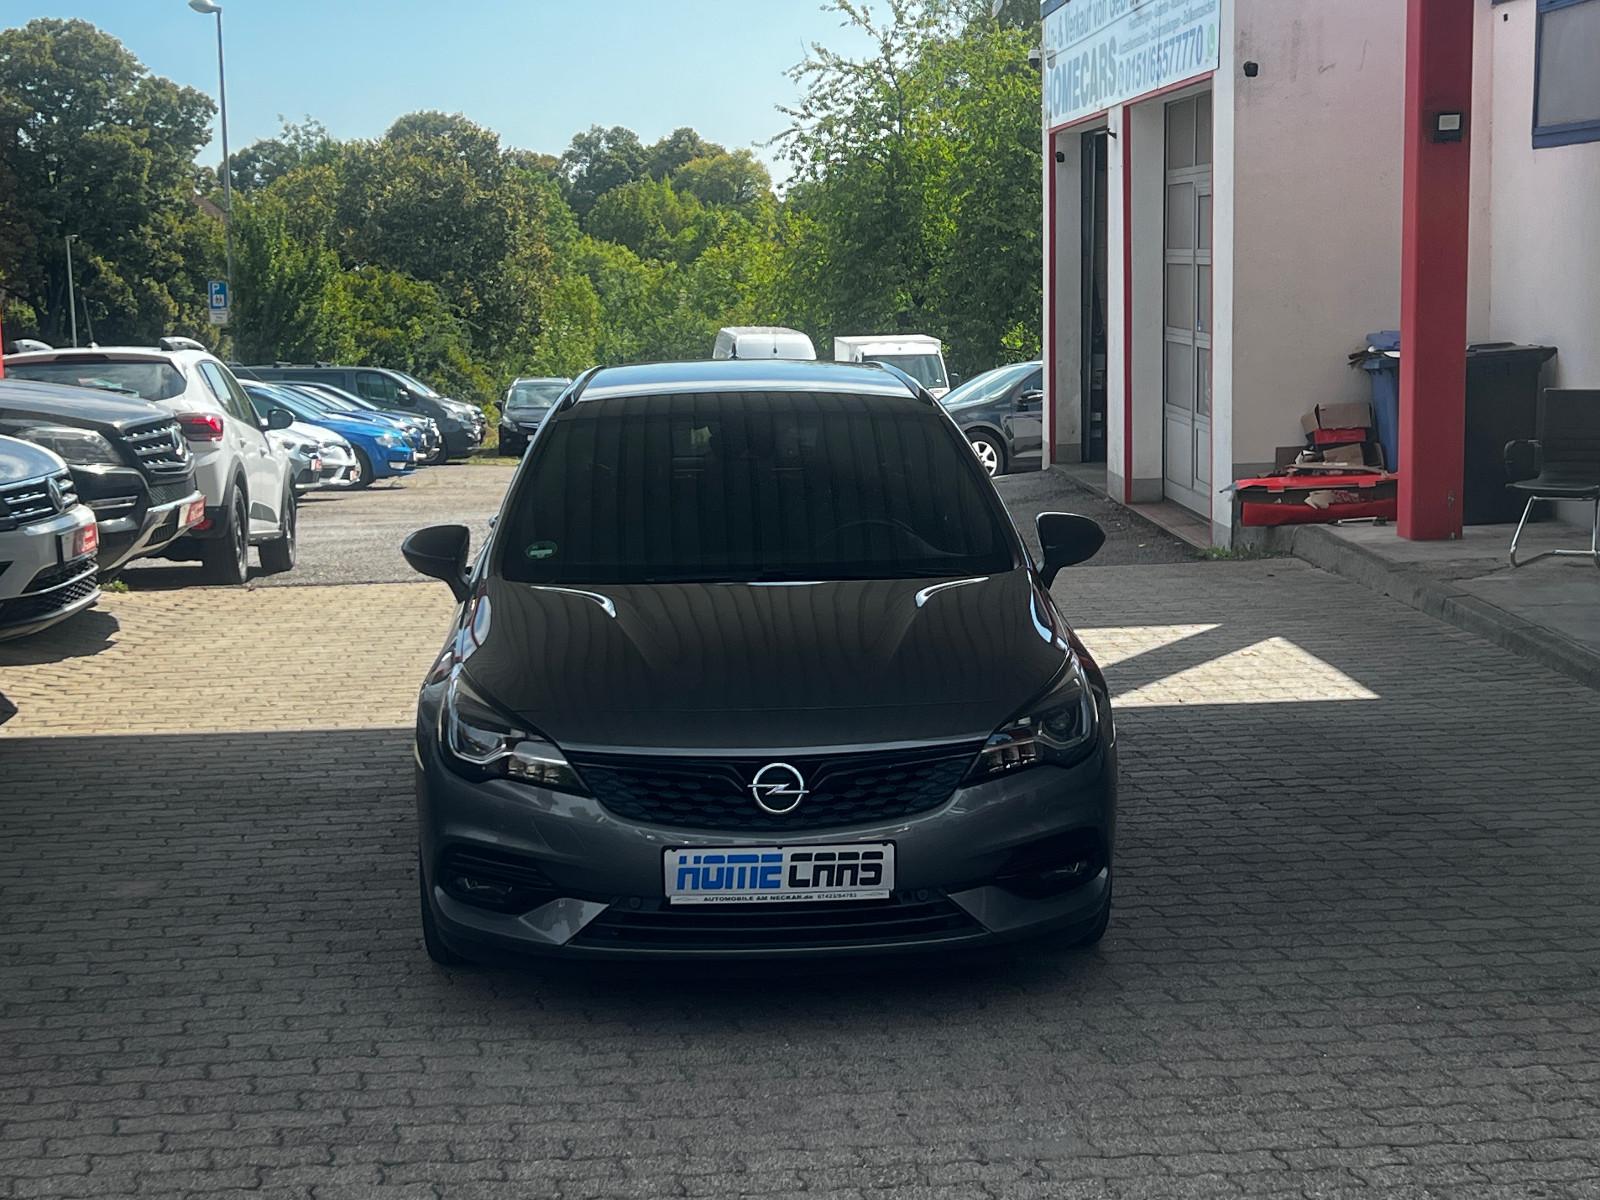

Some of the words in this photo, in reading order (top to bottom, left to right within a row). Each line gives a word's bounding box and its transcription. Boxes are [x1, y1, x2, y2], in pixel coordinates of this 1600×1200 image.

[212, 283, 220, 294] P
[677, 853, 783, 890] HOME
[788, 851, 884, 888] CARS
